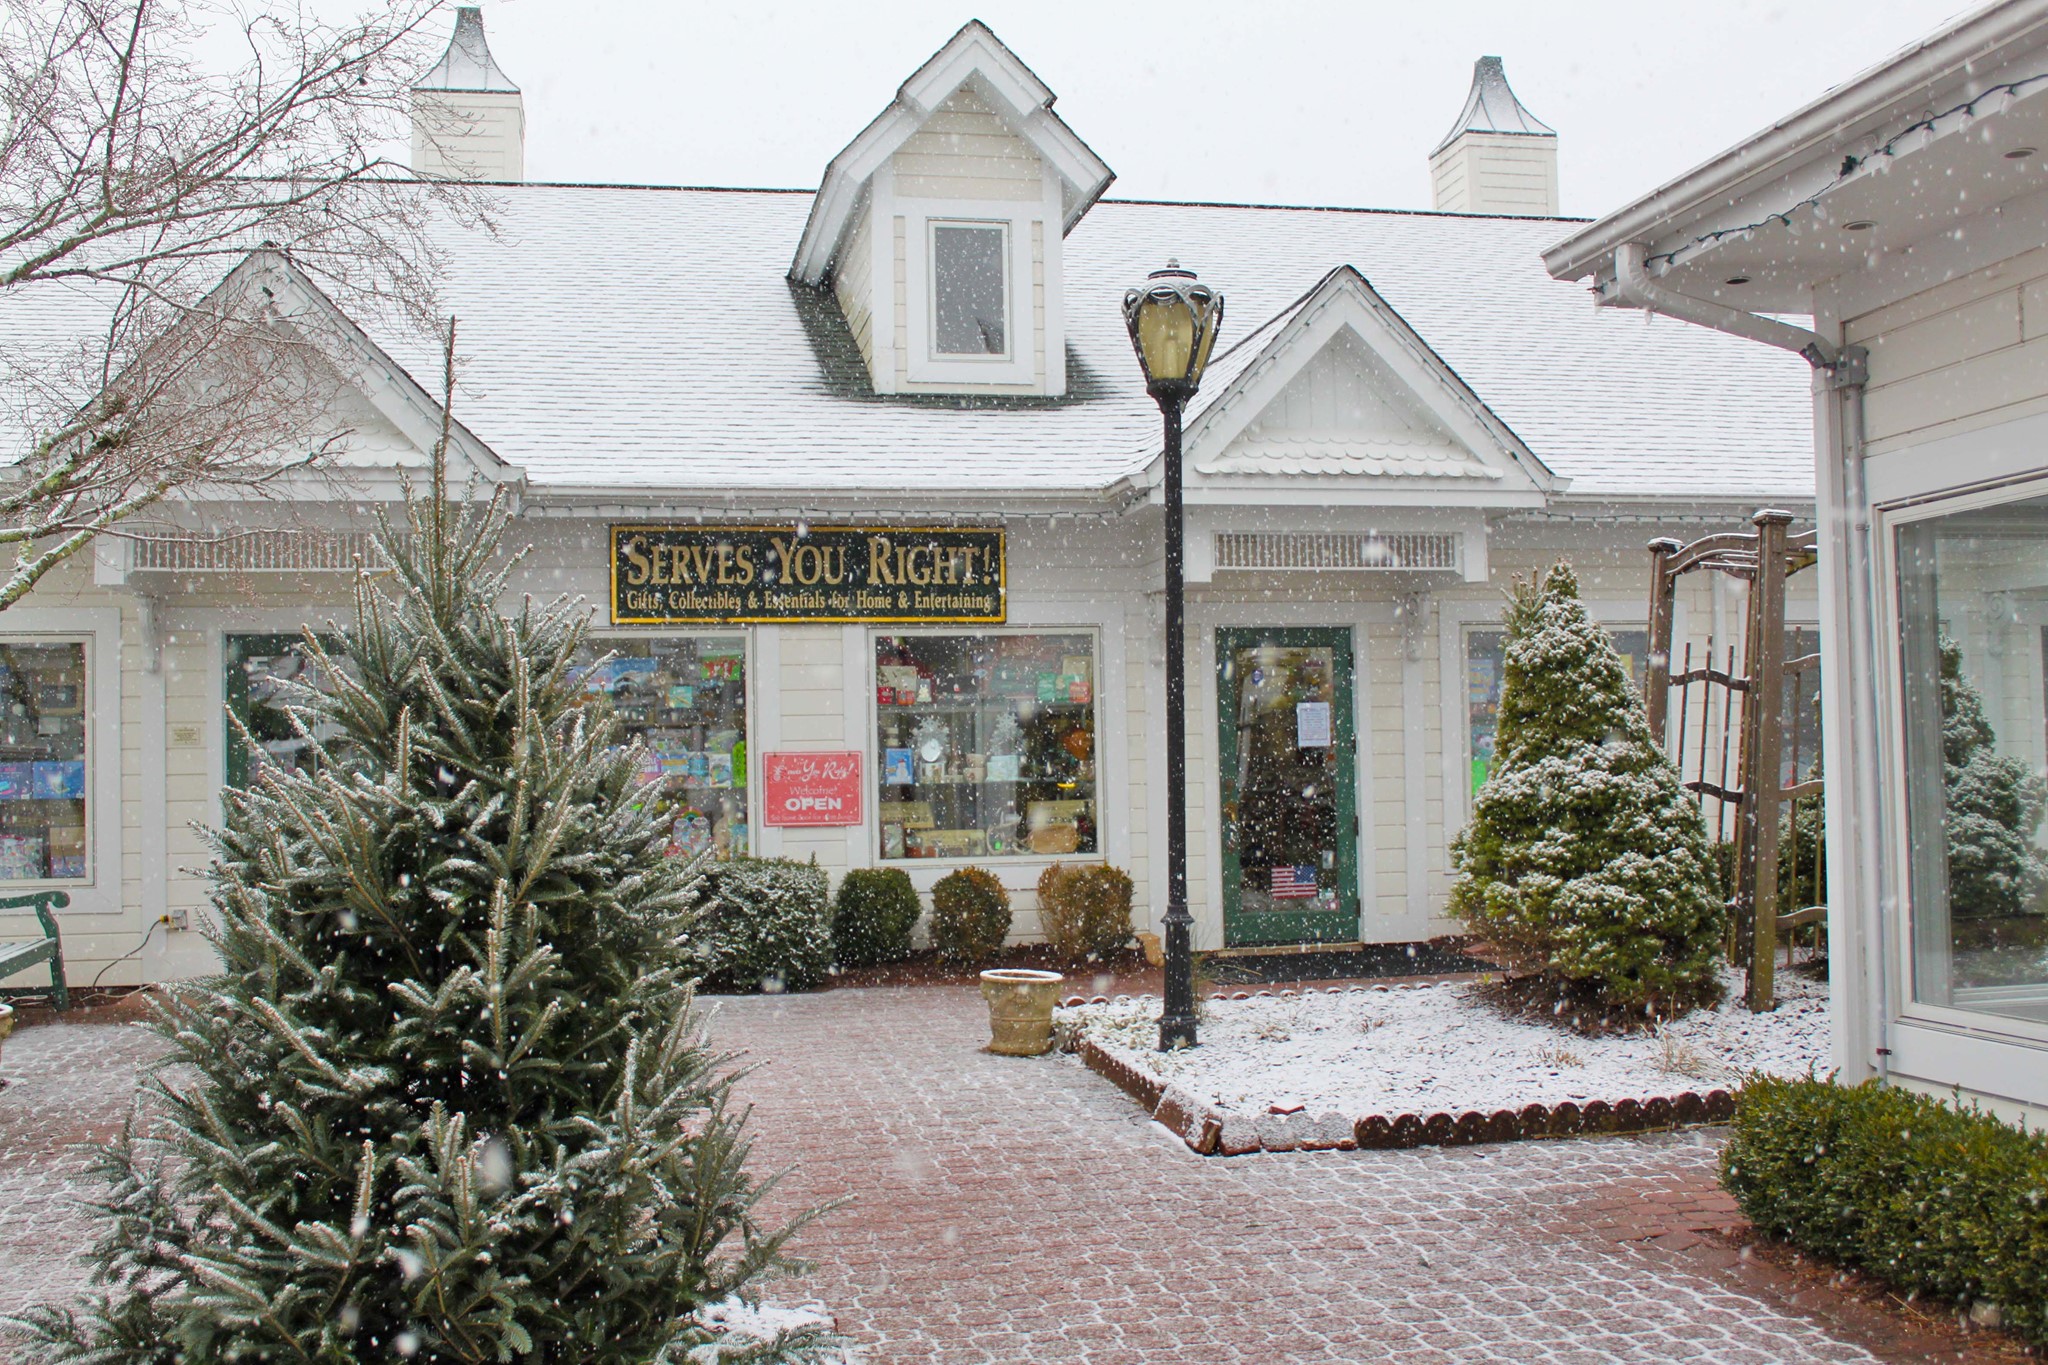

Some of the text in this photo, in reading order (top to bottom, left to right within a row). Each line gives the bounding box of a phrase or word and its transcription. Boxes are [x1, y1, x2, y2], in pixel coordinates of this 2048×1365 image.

[626, 536, 992, 585] SERVES YOU RIGHT!
[627, 590, 991, 613] Gifts, Collectibles & Essentials for Home & Entertaining
[785, 797, 842, 811] OPEN
